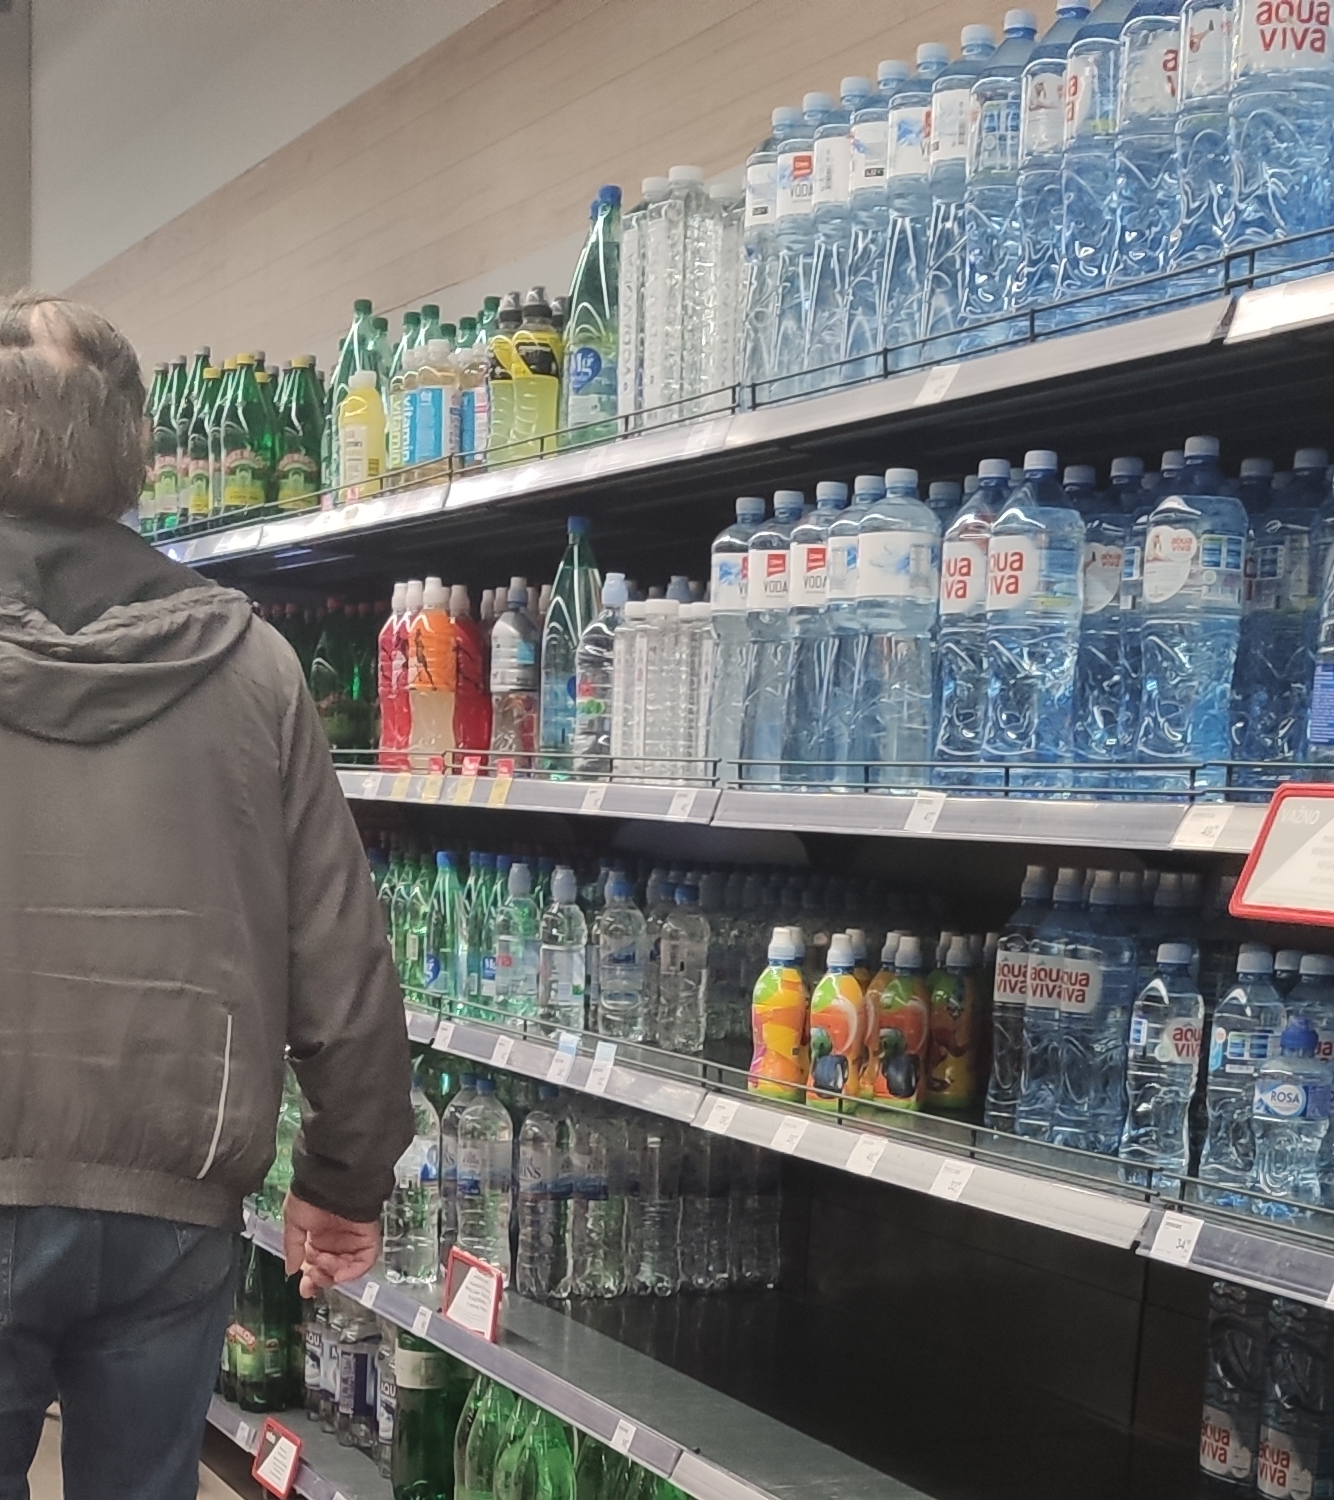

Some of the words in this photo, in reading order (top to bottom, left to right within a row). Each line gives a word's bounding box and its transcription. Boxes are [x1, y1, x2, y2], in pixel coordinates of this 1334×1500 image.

[1259, 28, 1327, 54] viva
[403, 390, 414, 464] vitamin
[763, 580, 788, 594] VODA
[1280, 806, 1320, 825] VAŽNO
[1270, 1089, 1301, 1106] ROSA
[1201, 1421, 1231, 1448] aqua
[1200, 1441, 1228, 1465] viva
[1259, 1440, 1290, 1470] aqua
[1258, 1460, 1287, 1488] viva
